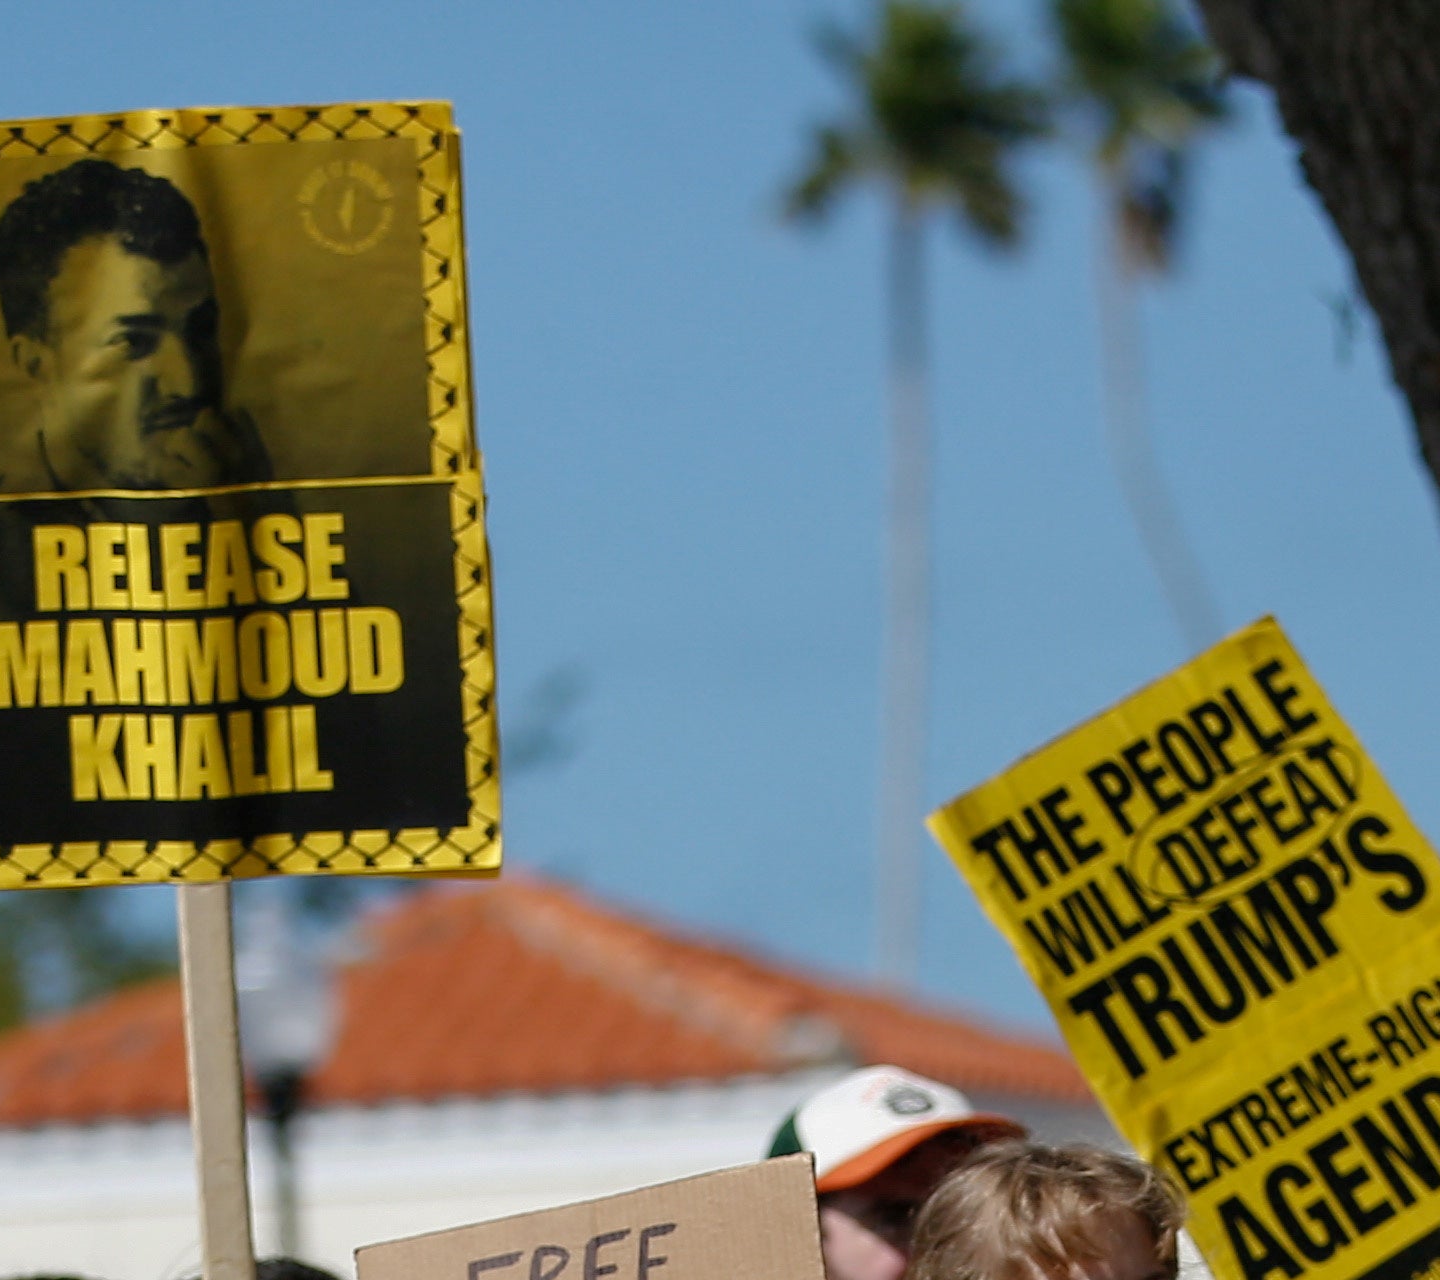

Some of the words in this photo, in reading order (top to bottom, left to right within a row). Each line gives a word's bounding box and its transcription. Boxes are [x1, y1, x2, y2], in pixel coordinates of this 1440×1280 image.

[32, 513, 349, 611] RELEASE
[69, 705, 333, 800] KHALIL
[971, 787, 1105, 901] THE
[1086, 659, 1318, 836] PEOPLE
[1024, 861, 1171, 978] WILL
[1156, 739, 1362, 899] DEFEAT
[1068, 815, 1429, 1081] TRUMP'S
